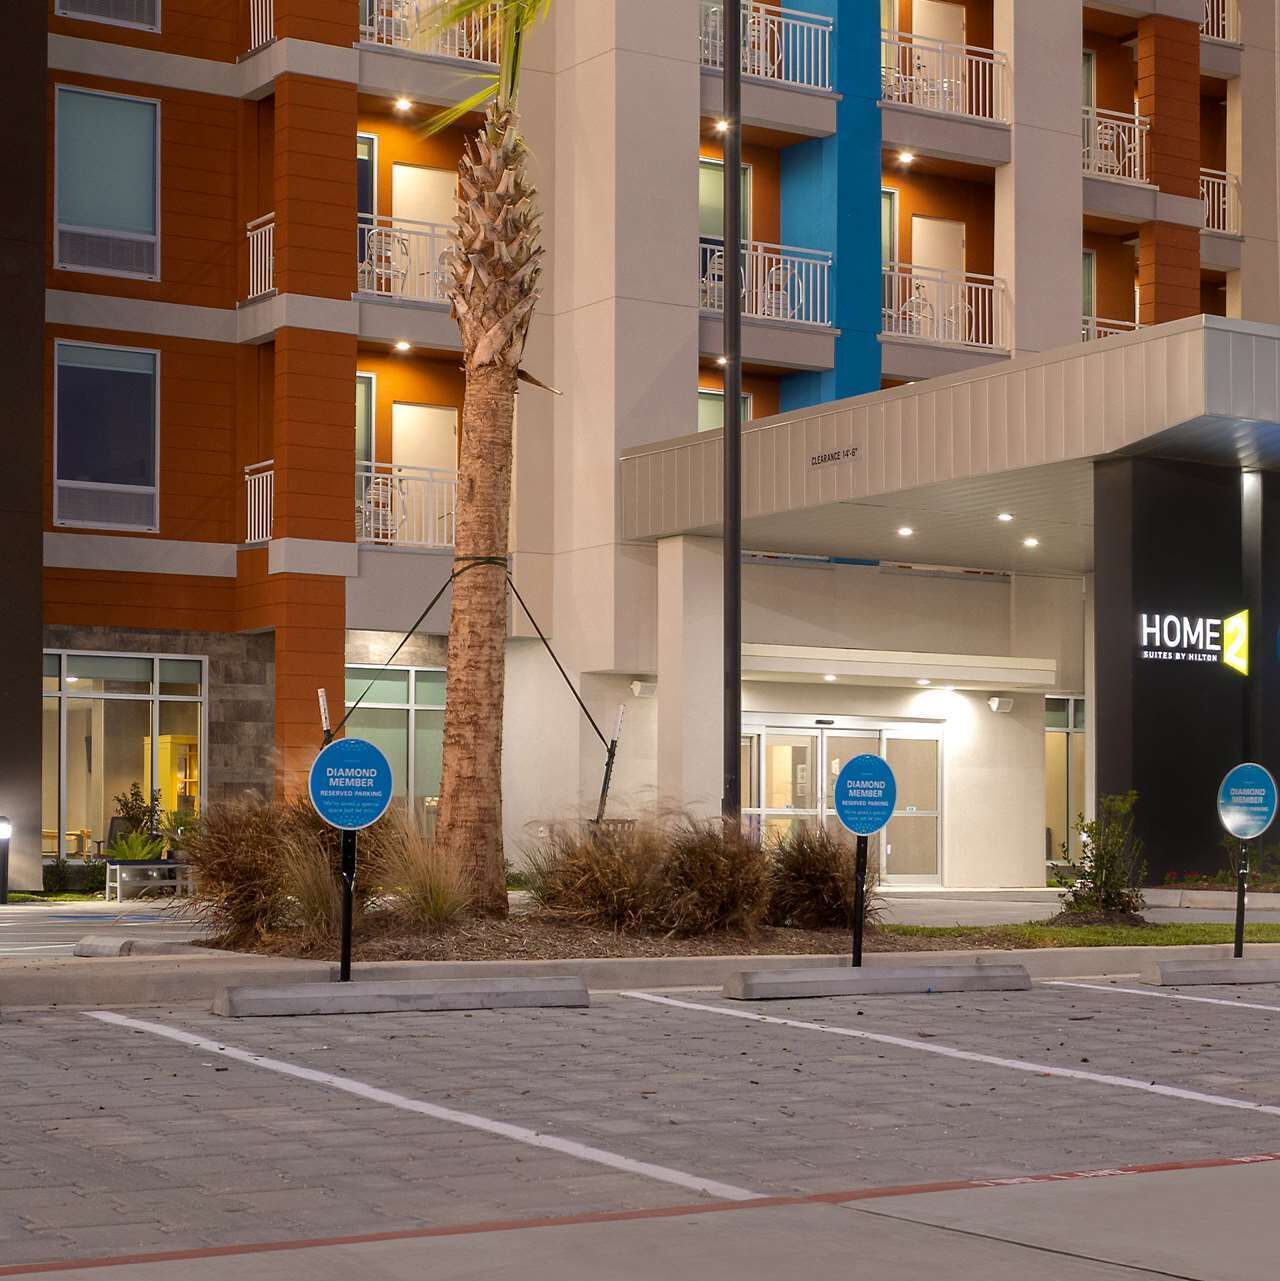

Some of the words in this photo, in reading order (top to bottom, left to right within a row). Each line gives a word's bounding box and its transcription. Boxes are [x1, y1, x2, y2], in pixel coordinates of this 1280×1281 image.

[811, 450, 841, 466] CLEARANCE
[1141, 613, 1221, 651] HOME
[1226, 616, 1247, 672] 2
[1143, 650, 1173, 660] SUITES
[1175, 652, 1186, 661] BY
[1188, 652, 1218, 663] HILTON
[326, 768, 377, 777] DIAMOND
[329, 778, 374, 787] MEMBER
[847, 780, 886, 789] DIAMOND
[849, 790, 883, 798] MEMBER
